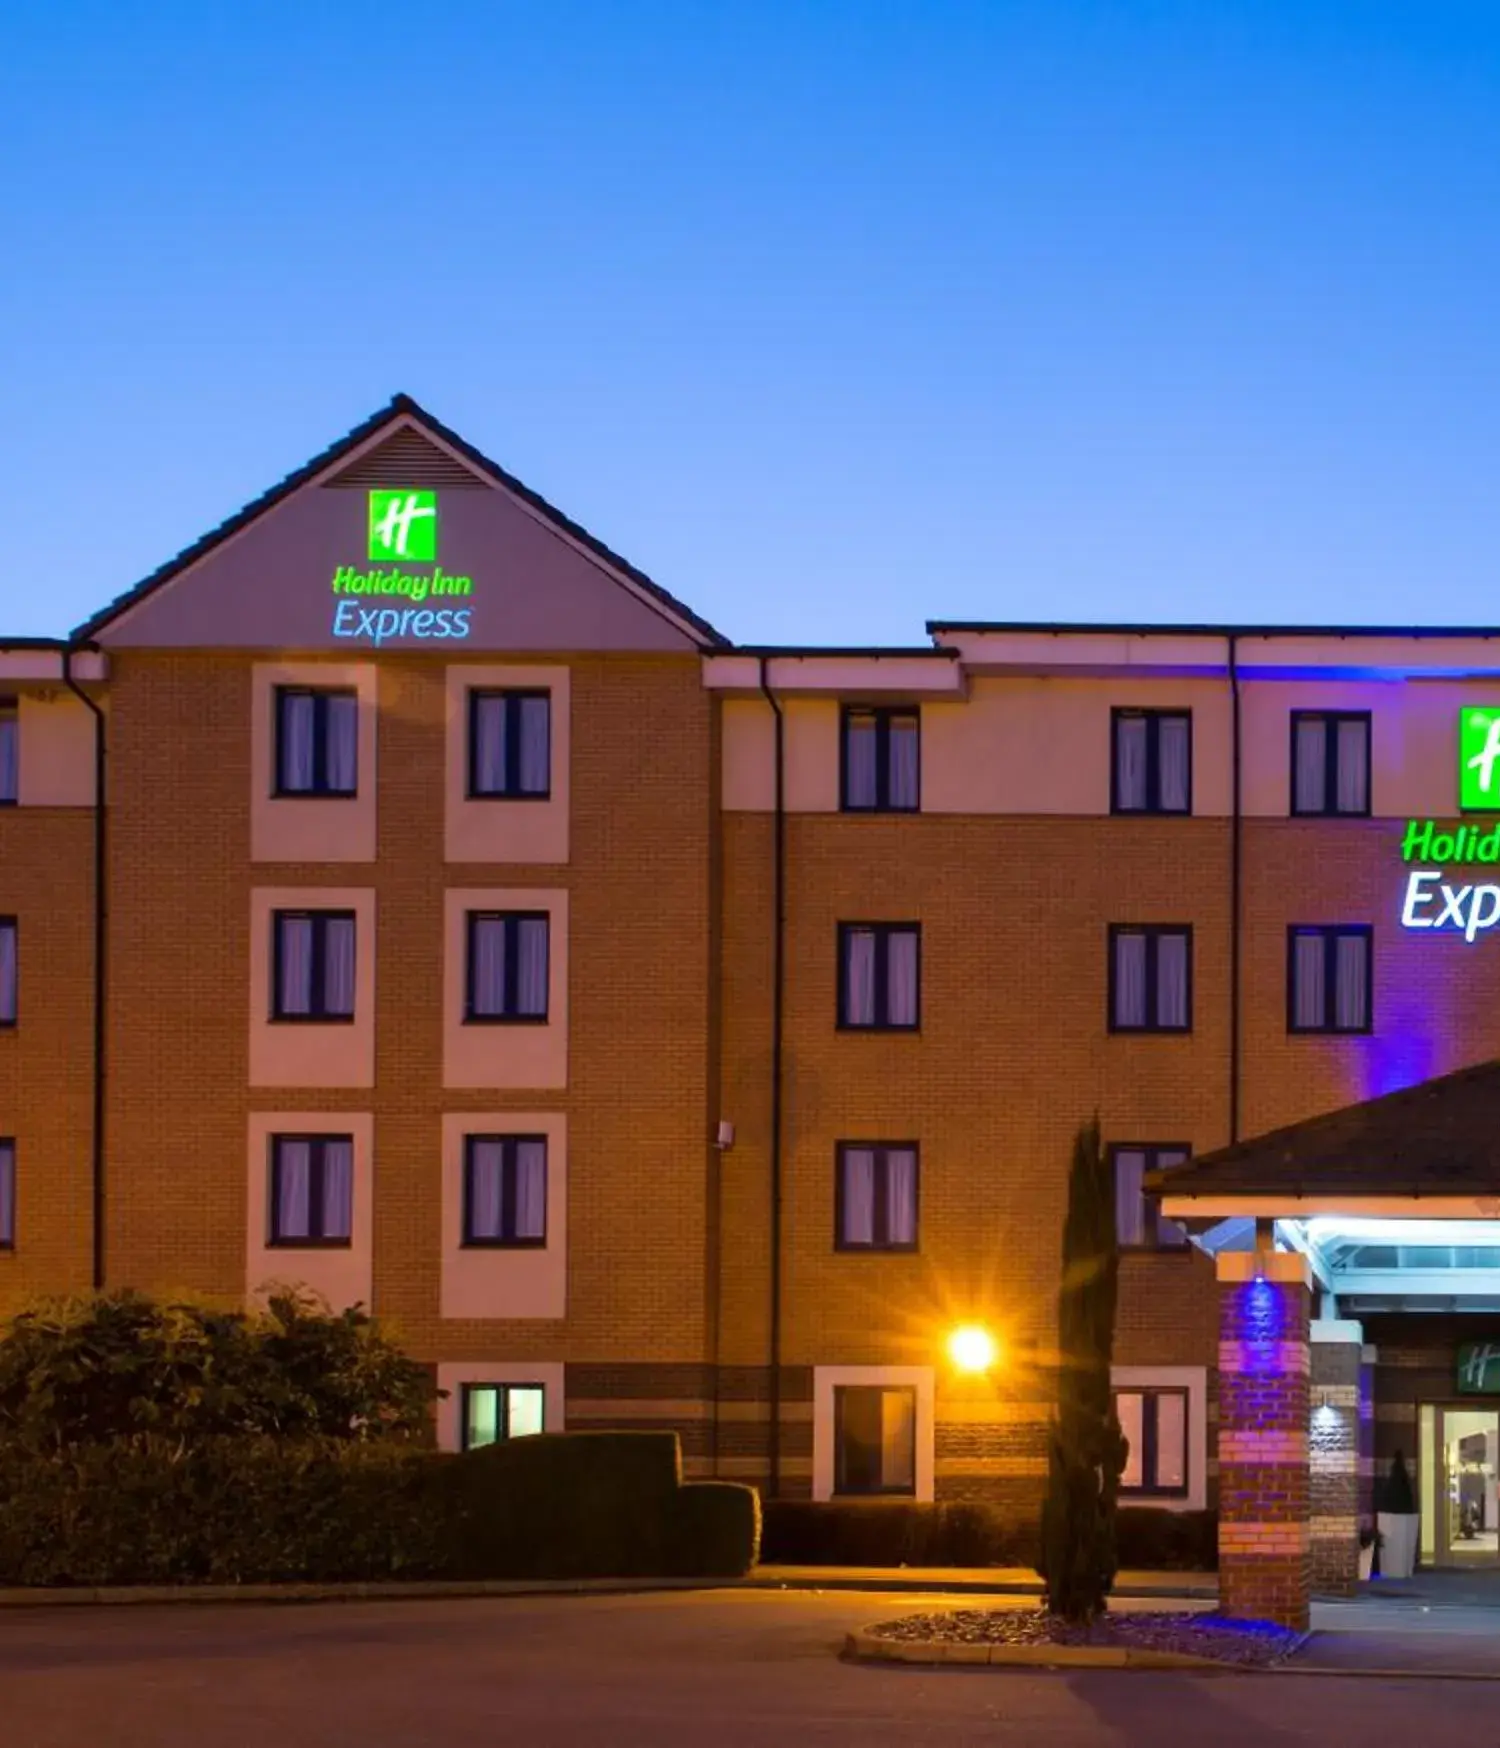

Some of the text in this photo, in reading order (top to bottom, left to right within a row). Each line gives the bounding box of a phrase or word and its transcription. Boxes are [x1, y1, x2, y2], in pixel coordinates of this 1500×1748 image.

[332, 566, 471, 601] Holiday Inn
[333, 600, 472, 647] Express
